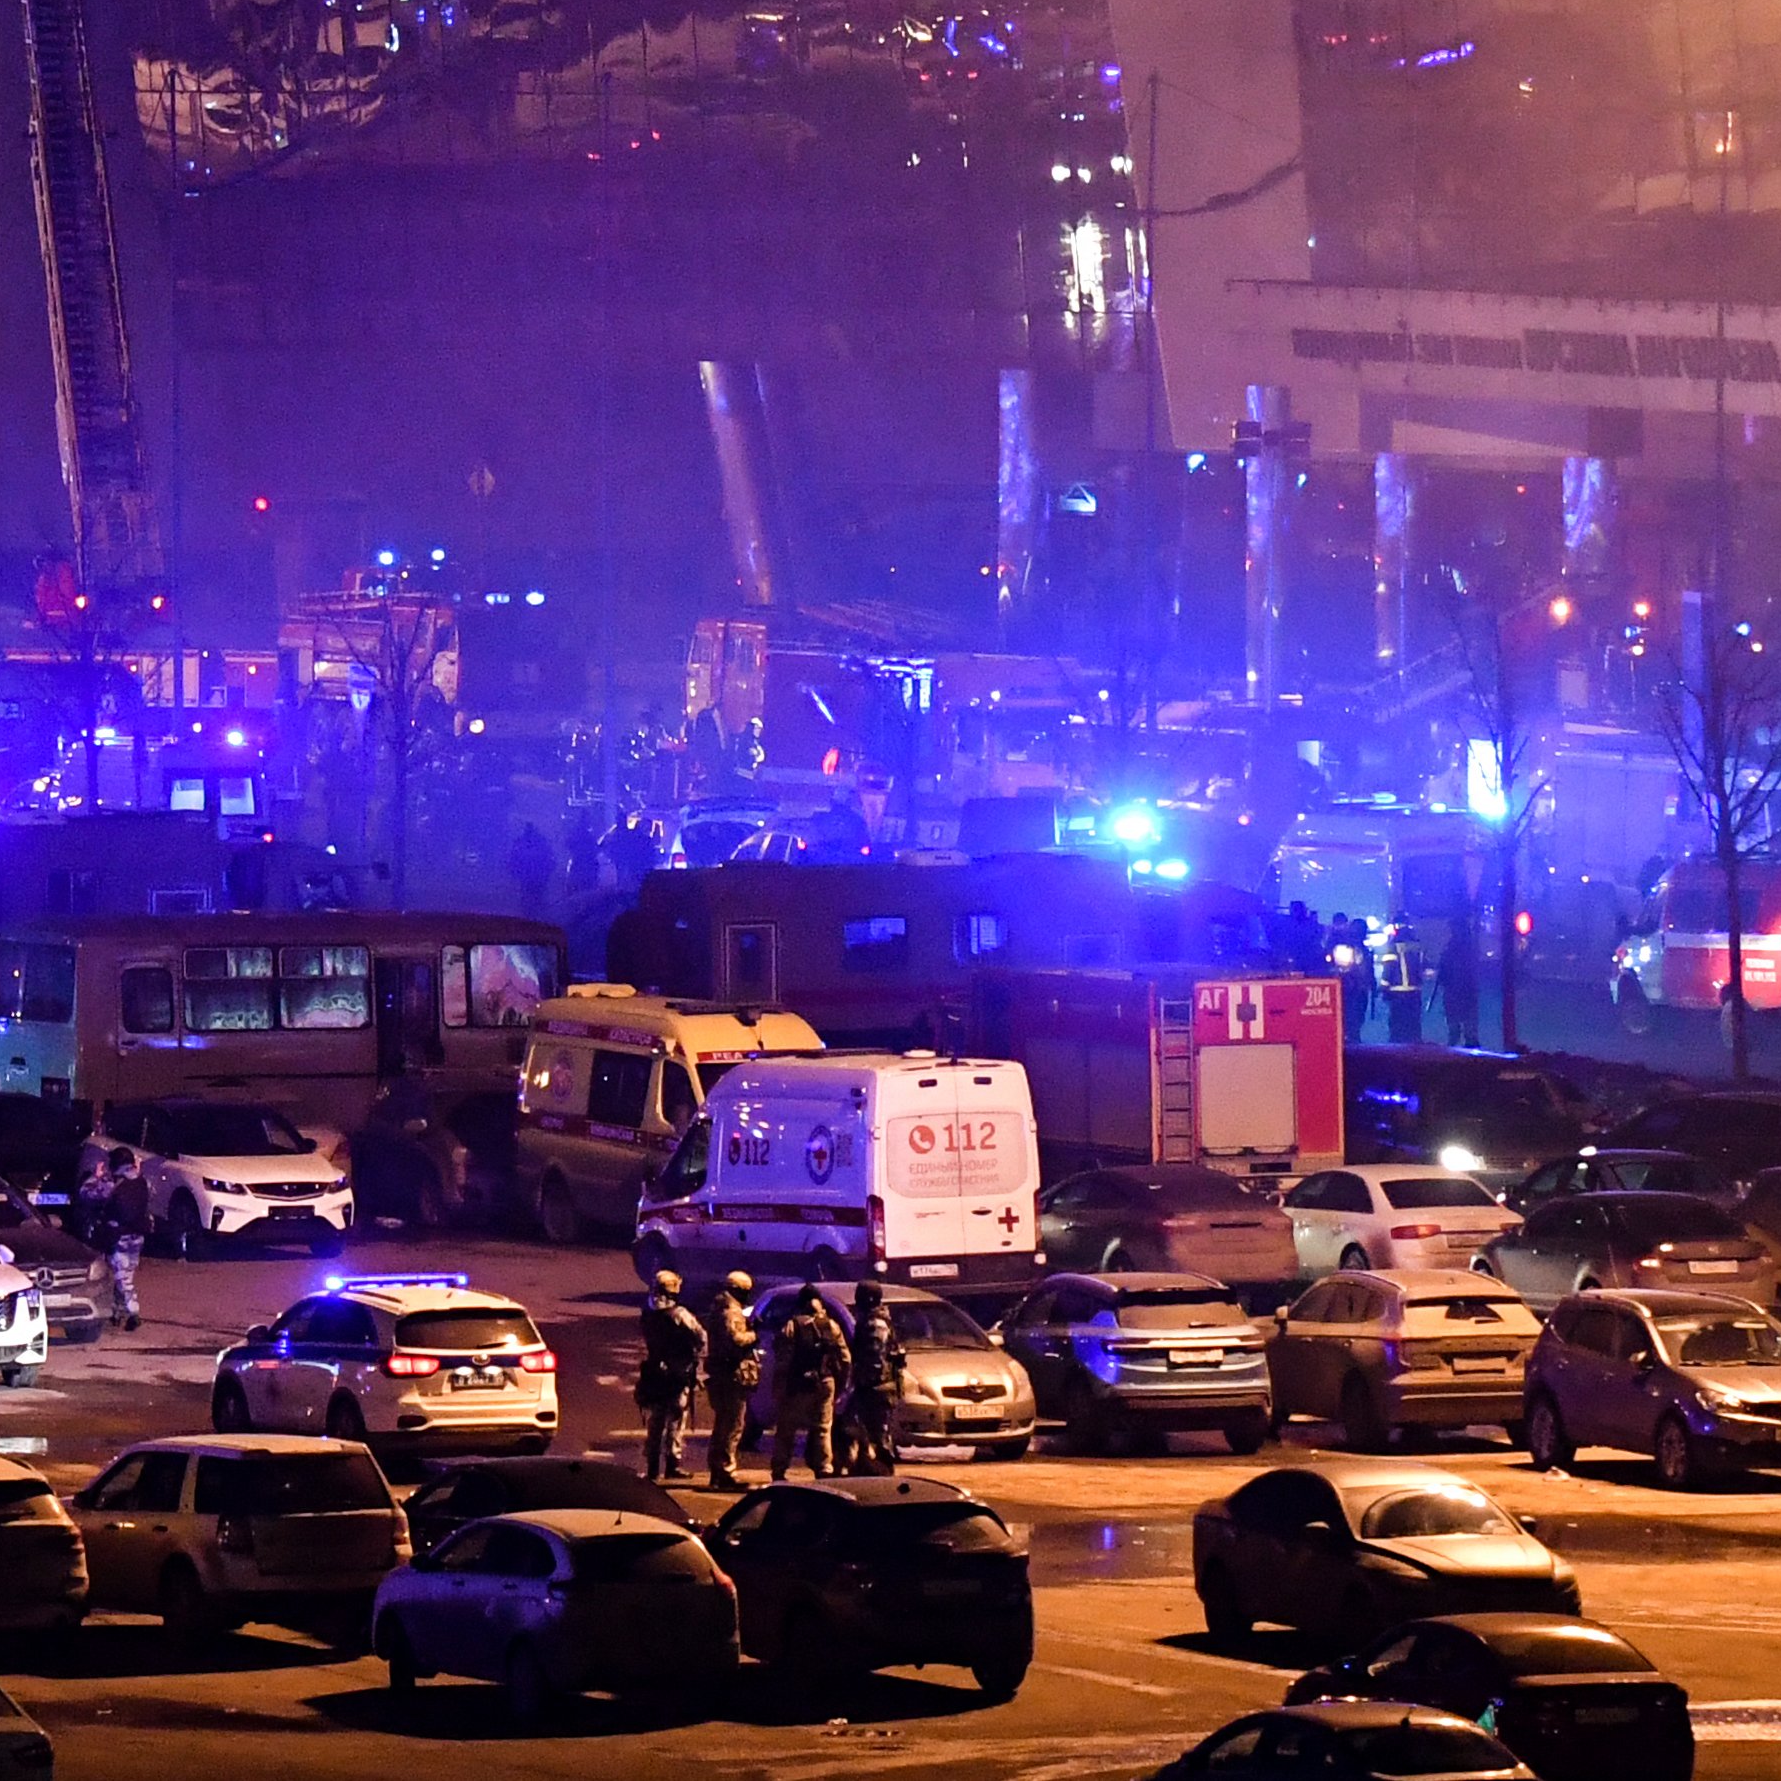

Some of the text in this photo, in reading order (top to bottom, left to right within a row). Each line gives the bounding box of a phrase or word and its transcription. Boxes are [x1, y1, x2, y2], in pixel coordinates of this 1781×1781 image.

[1199, 988, 1225, 1010] АГ
[1305, 986, 1332, 1007] 204
[943, 1121, 996, 1152] 112
[743, 1138, 771, 1165] 112
